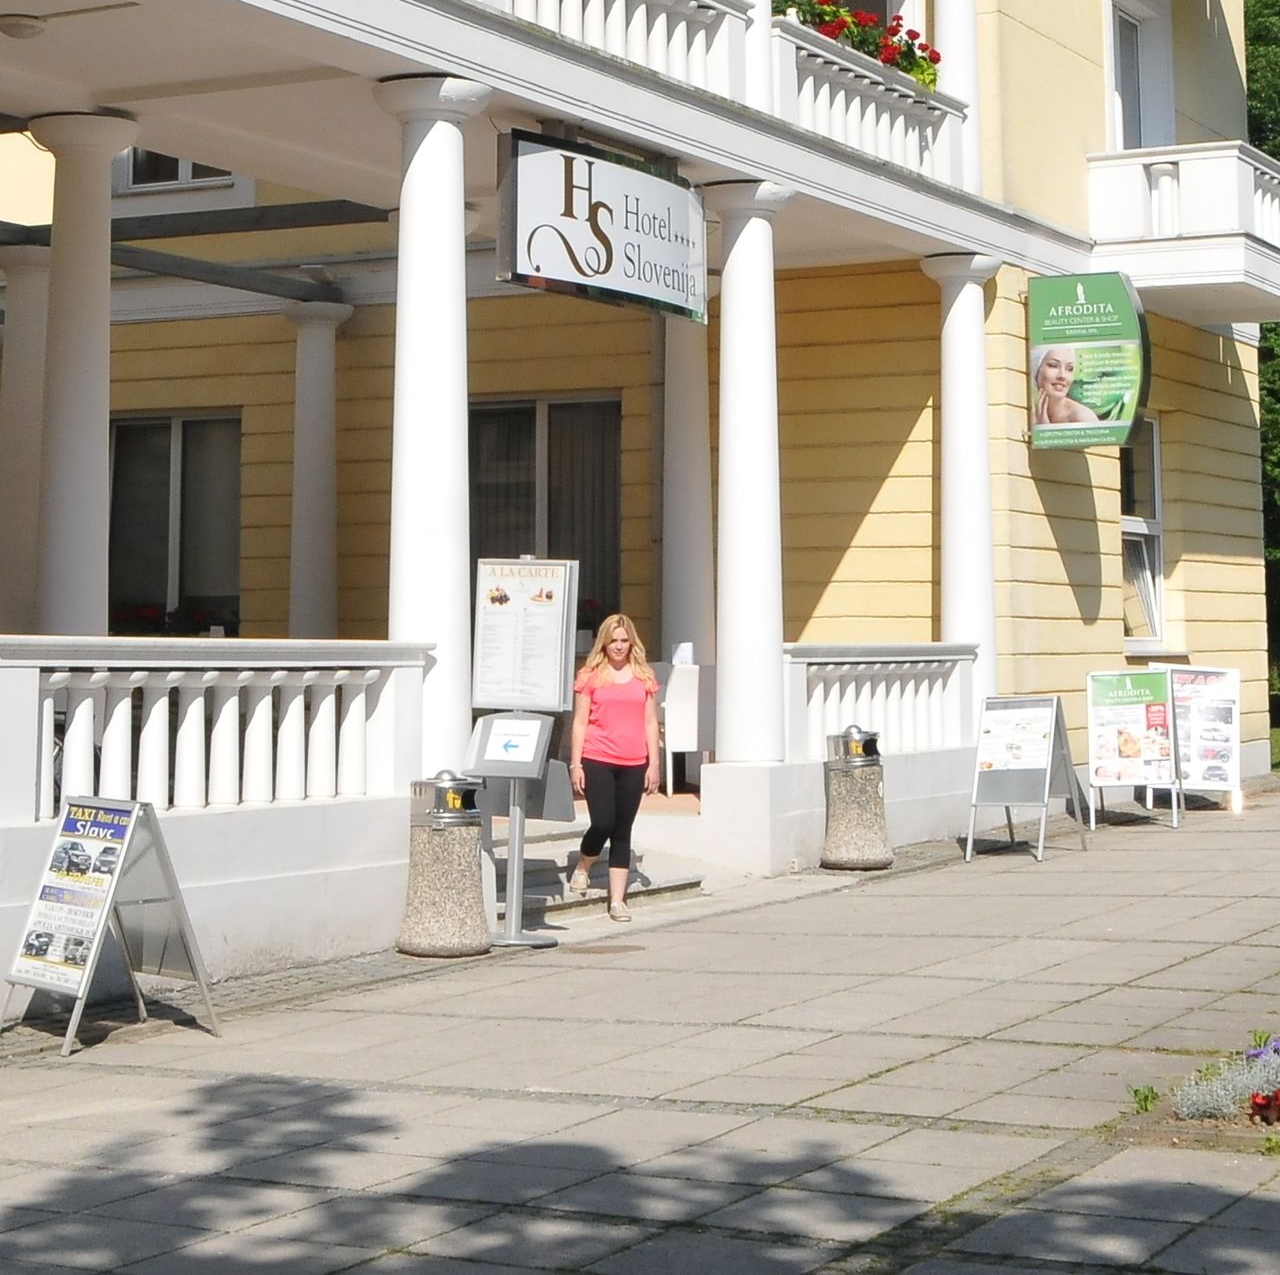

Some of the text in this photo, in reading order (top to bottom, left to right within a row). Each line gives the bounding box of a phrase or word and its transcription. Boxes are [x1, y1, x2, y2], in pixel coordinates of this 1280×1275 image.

[623, 193, 672, 244] Hotel
[623, 242, 697, 302] Slovenija
[1048, 303, 1114, 317] AFRODITA
[1043, 318, 1069, 326] BEAUTY
[1069, 317, 1095, 325] CENTER
[1101, 315, 1119, 323] SHOP
[500, 567, 514, 577] LA
[518, 567, 560, 578] CARTE
[1108, 689, 1151, 698] AFRODITA
[69, 807, 96, 821] TAXI
[75, 821, 115, 839] Slavc
